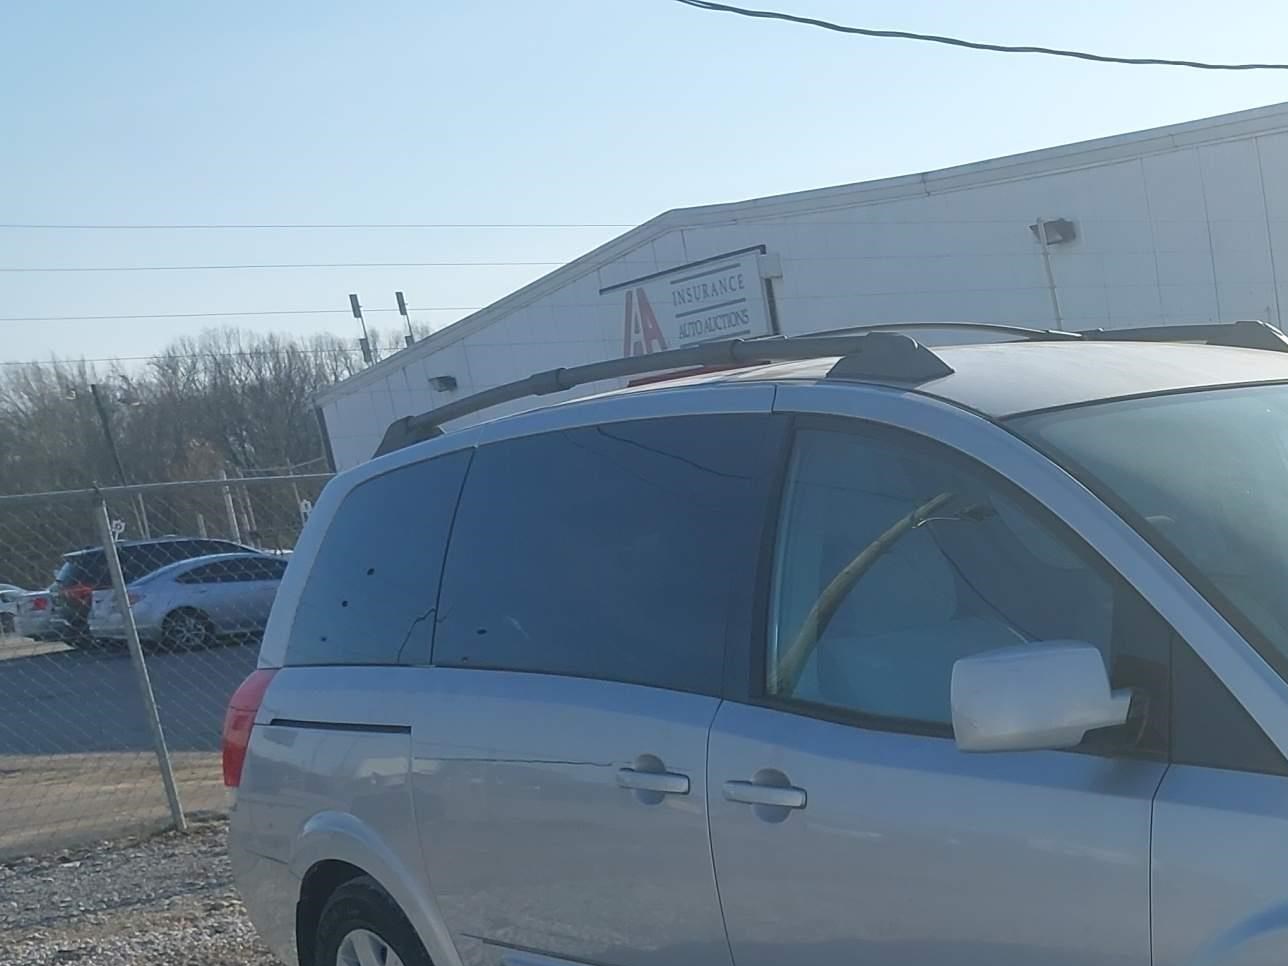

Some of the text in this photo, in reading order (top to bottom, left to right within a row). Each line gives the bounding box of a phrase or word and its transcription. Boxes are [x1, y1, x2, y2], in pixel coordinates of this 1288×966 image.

[671, 273, 745, 307] INSURANCE
[679, 308, 750, 339] AUTO AUCTIONS
